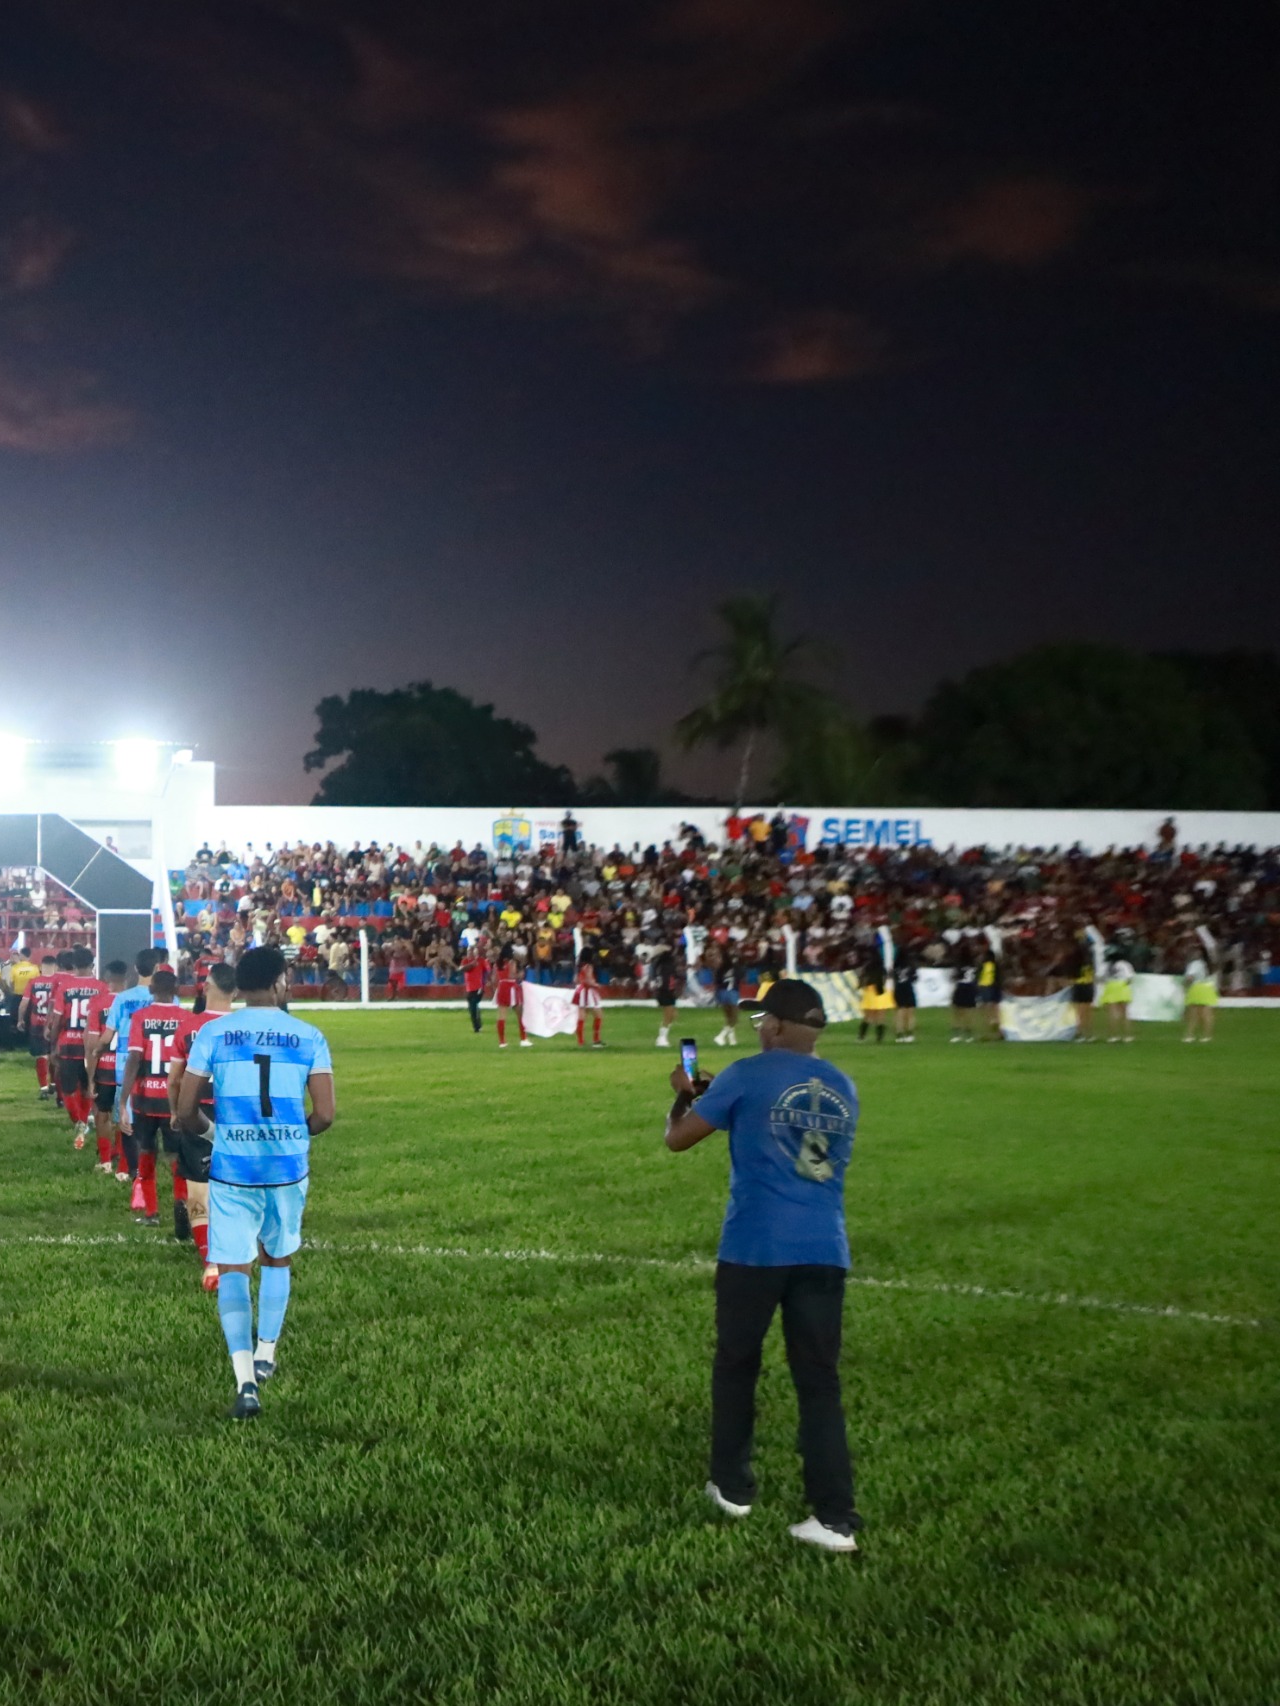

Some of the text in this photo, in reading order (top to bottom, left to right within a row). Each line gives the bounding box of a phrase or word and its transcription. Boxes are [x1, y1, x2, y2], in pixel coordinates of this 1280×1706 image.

[820, 818, 932, 846] SEMEL
[256, 1029, 300, 1048] ZÉLIO
[253, 1053, 272, 1117] 1
[226, 1126, 302, 1142] ARRASTÃO
